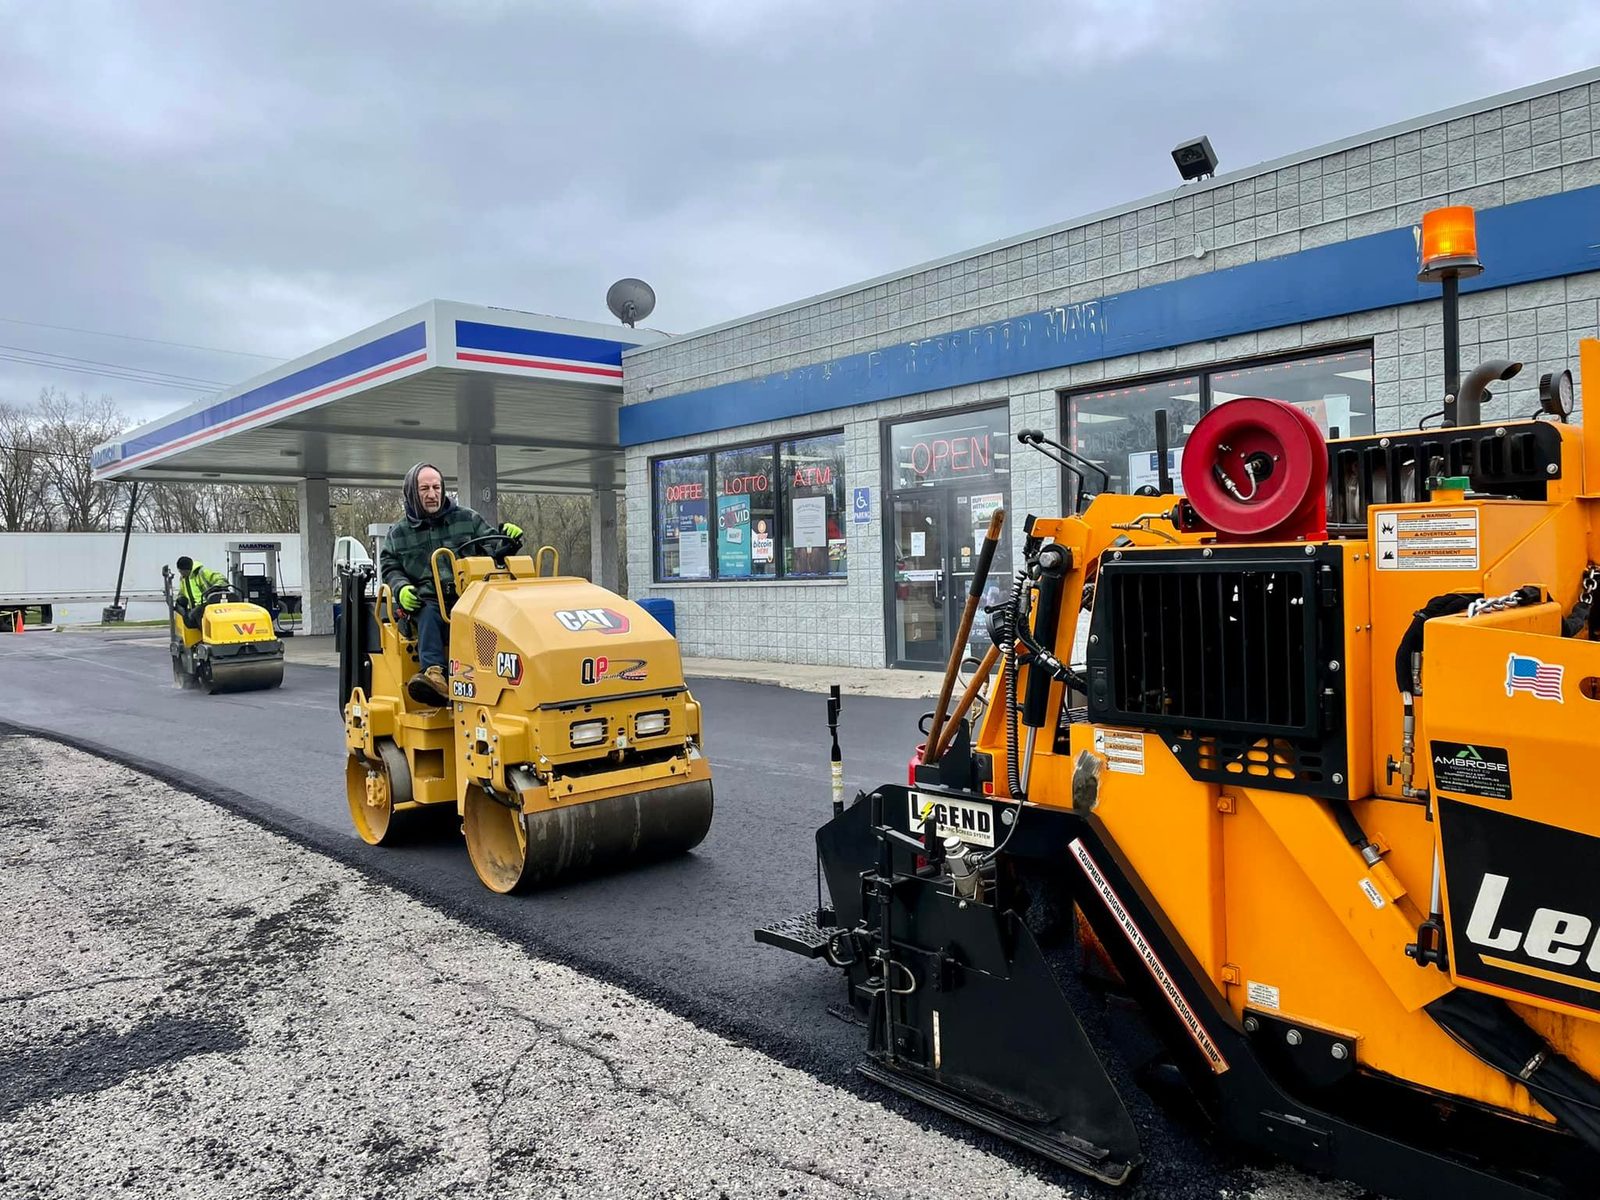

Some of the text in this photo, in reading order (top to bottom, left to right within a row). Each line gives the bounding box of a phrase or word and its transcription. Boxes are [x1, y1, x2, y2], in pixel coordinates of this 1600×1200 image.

[1138, 421, 1179, 448] CAD
[912, 434, 989, 474] OPEN
[725, 475, 768, 494] LOTTO
[793, 466, 832, 487] ATM
[667, 483, 703, 501] COFFEE
[555, 609, 613, 631] CAT
[497, 652, 517, 678] CAT
[582, 657, 608, 684] QP
[453, 681, 473, 697] CB1.8
[1434, 756, 1508, 772] AMBROSE
[911, 794, 991, 833] LGEND
[973, 832, 991, 840] SYSTEM
[1466, 872, 1600, 974] Le
[1102, 886, 1126, 922] DESIGNED
[1124, 918, 1138, 940] WITH
[1136, 937, 1148, 955] THE
[1146, 952, 1164, 980] PAVING
[1163, 977, 1199, 1034] PROFESSIONAL
[1197, 1028, 1205, 1044] IN
